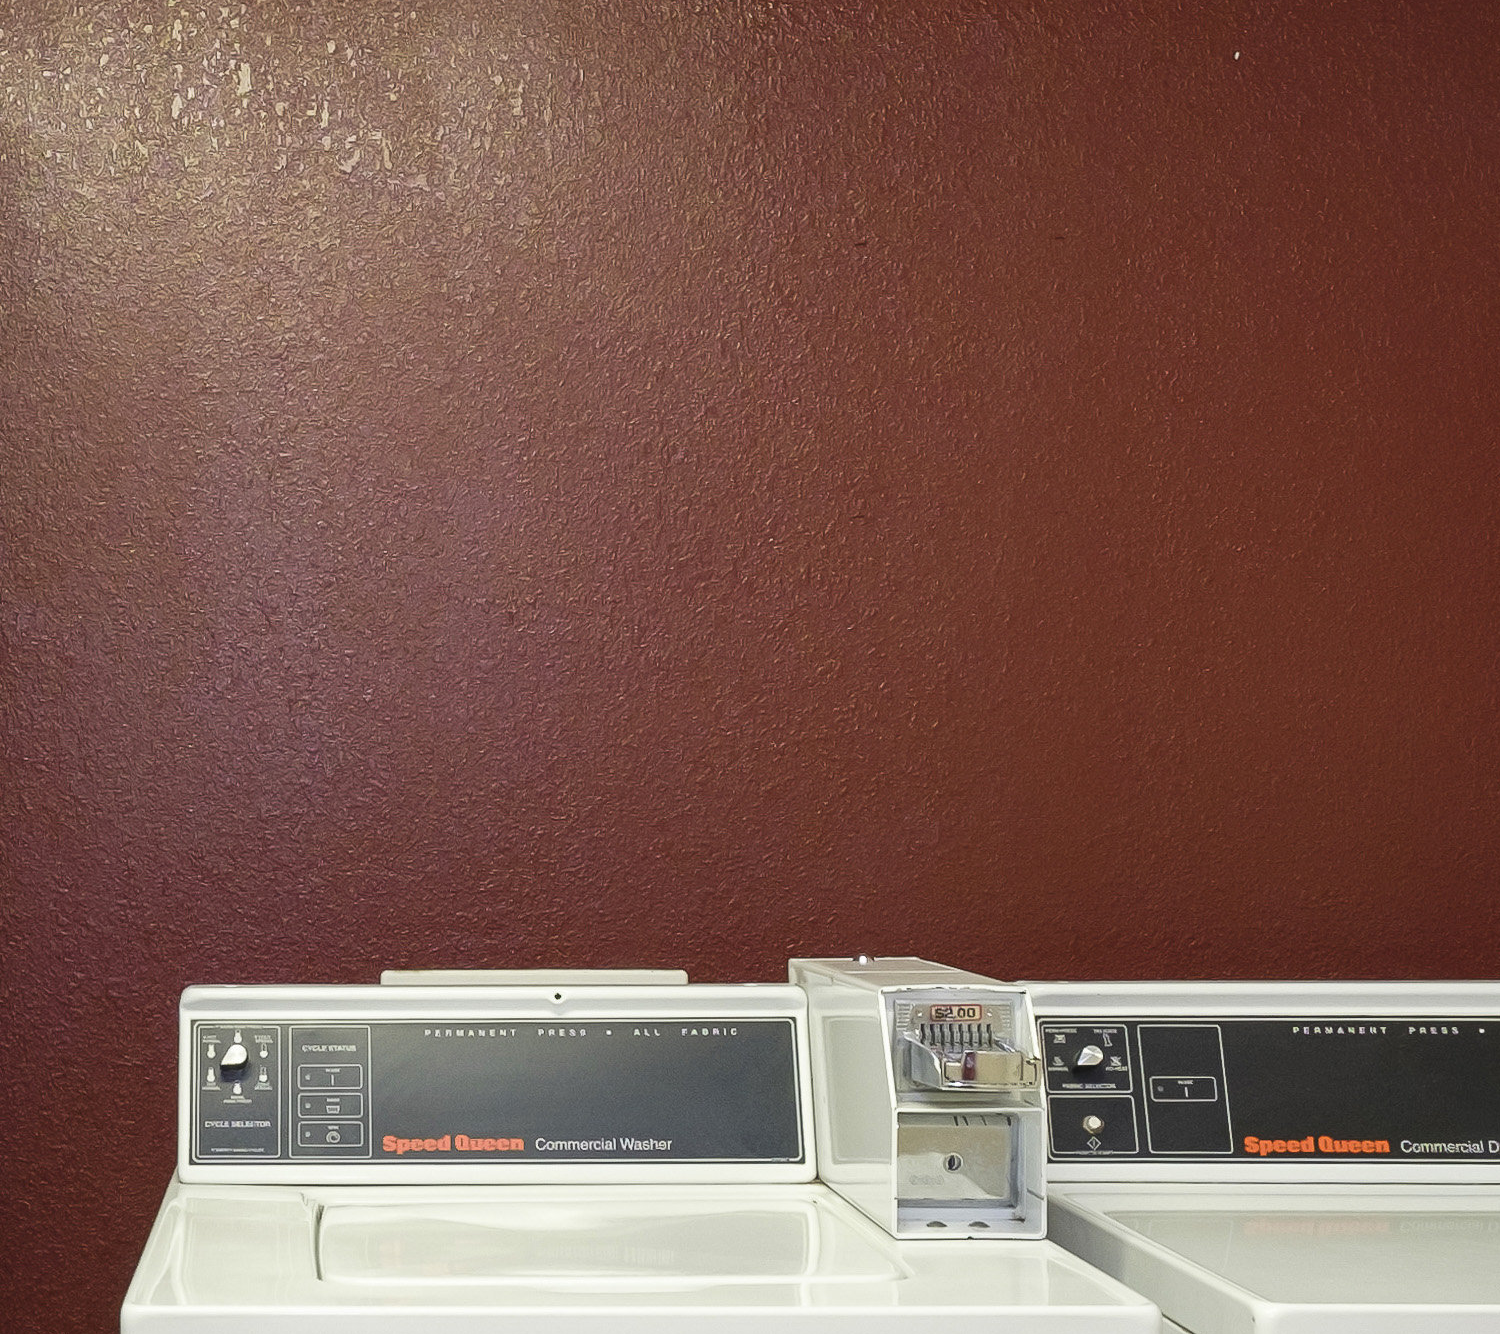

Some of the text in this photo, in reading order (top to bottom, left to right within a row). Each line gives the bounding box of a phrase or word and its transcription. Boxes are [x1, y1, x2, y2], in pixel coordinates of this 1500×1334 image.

[424, 1027, 738, 1038] PERMANENT PRESS ALL FABRIC
[1293, 1025, 1388, 1035] PERMANENT
[1408, 1026, 1459, 1035] PRESS
[382, 1134, 672, 1155] Speed Queen Commercial Washer
[1244, 1135, 1315, 1157] Speed
[1318, 1136, 1390, 1153] Queen
[1400, 1140, 1484, 1154] Commercial
